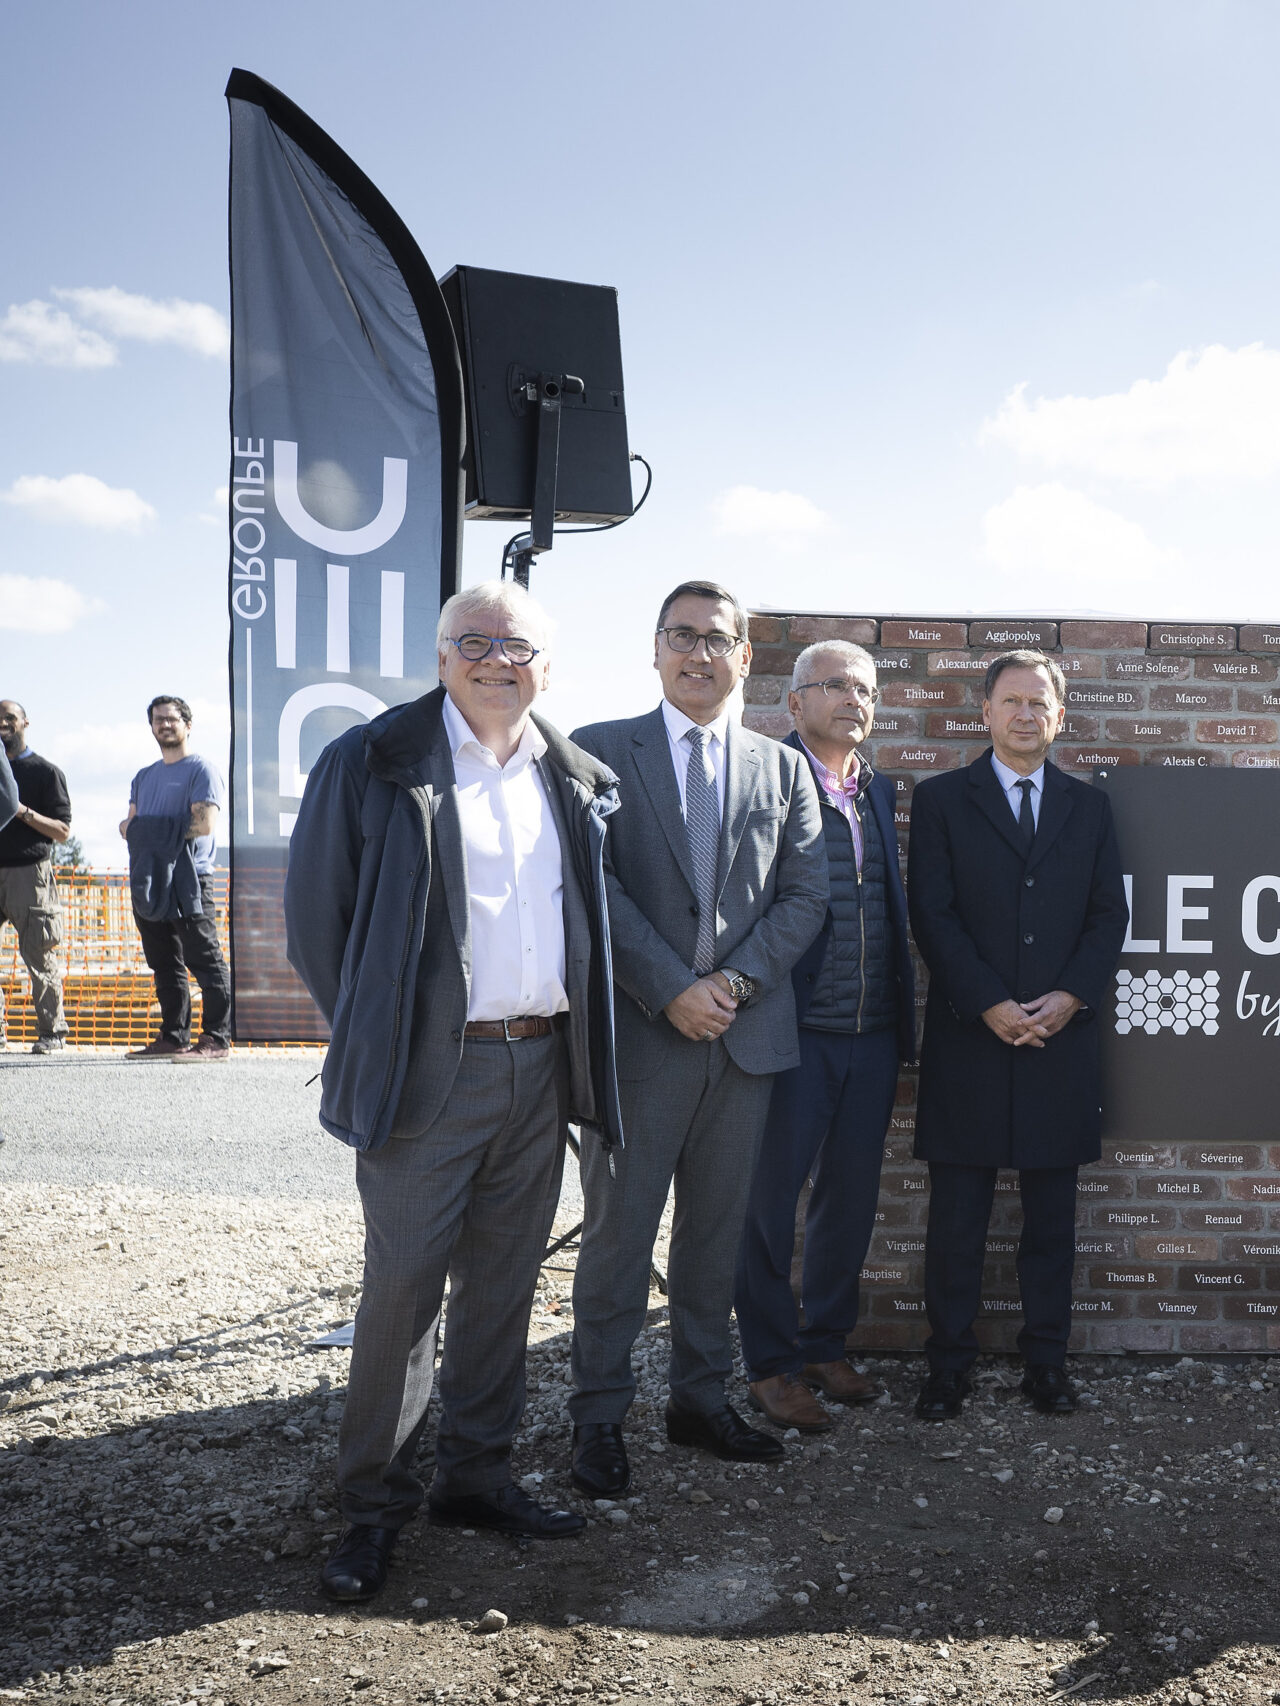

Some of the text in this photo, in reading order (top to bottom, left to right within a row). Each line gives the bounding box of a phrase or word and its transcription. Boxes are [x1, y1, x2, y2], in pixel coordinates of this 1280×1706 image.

[908, 629, 942, 641] Mairie
[985, 630, 1041, 644] Agglopolys
[1160, 633, 1227, 647] Christophe S.
[935, 658, 989, 670] Alexandre
[1072, 660, 1083, 671] B.
[1116, 661, 1180, 674] Anne Solene
[1212, 663, 1261, 674] Valérie B.
[903, 688, 945, 700] Thibaut
[1068, 691, 1136, 703] Christine BD.
[1175, 693, 1207, 704] Marco
[945, 720, 990, 732] Blandine
[1134, 724, 1162, 735] Louis
[1217, 725, 1257, 736] David T.
[900, 750, 937, 763] Audrey
[1076, 753, 1120, 767] Anthony
[1162, 756, 1208, 767] Alexis C.
[1121, 874, 1214, 954] LE
[1115, 1151, 1155, 1164] Quentin
[1200, 1153, 1244, 1164] Séverine
[903, 1179, 925, 1190] Paul
[1157, 1183, 1203, 1194] Michel B.
[1108, 1213, 1160, 1226] Philippe L.
[1205, 1214, 1242, 1225] Renaud
[886, 1240, 926, 1253] Virginie
[1105, 1242, 1115, 1253] R.
[1156, 1243, 1197, 1254] Gilles L.
[858, 1268, 902, 1281] -Baptiste
[1105, 1271, 1158, 1283] Thomas B.
[1194, 1273, 1245, 1284] Vincent G.
[893, 1300, 919, 1311] Yann
[982, 1300, 1023, 1311] Wilfried
[1100, 1301, 1114, 1311] M.
[1157, 1302, 1198, 1315] Vianney
[1246, 1302, 1278, 1316] Tifany
